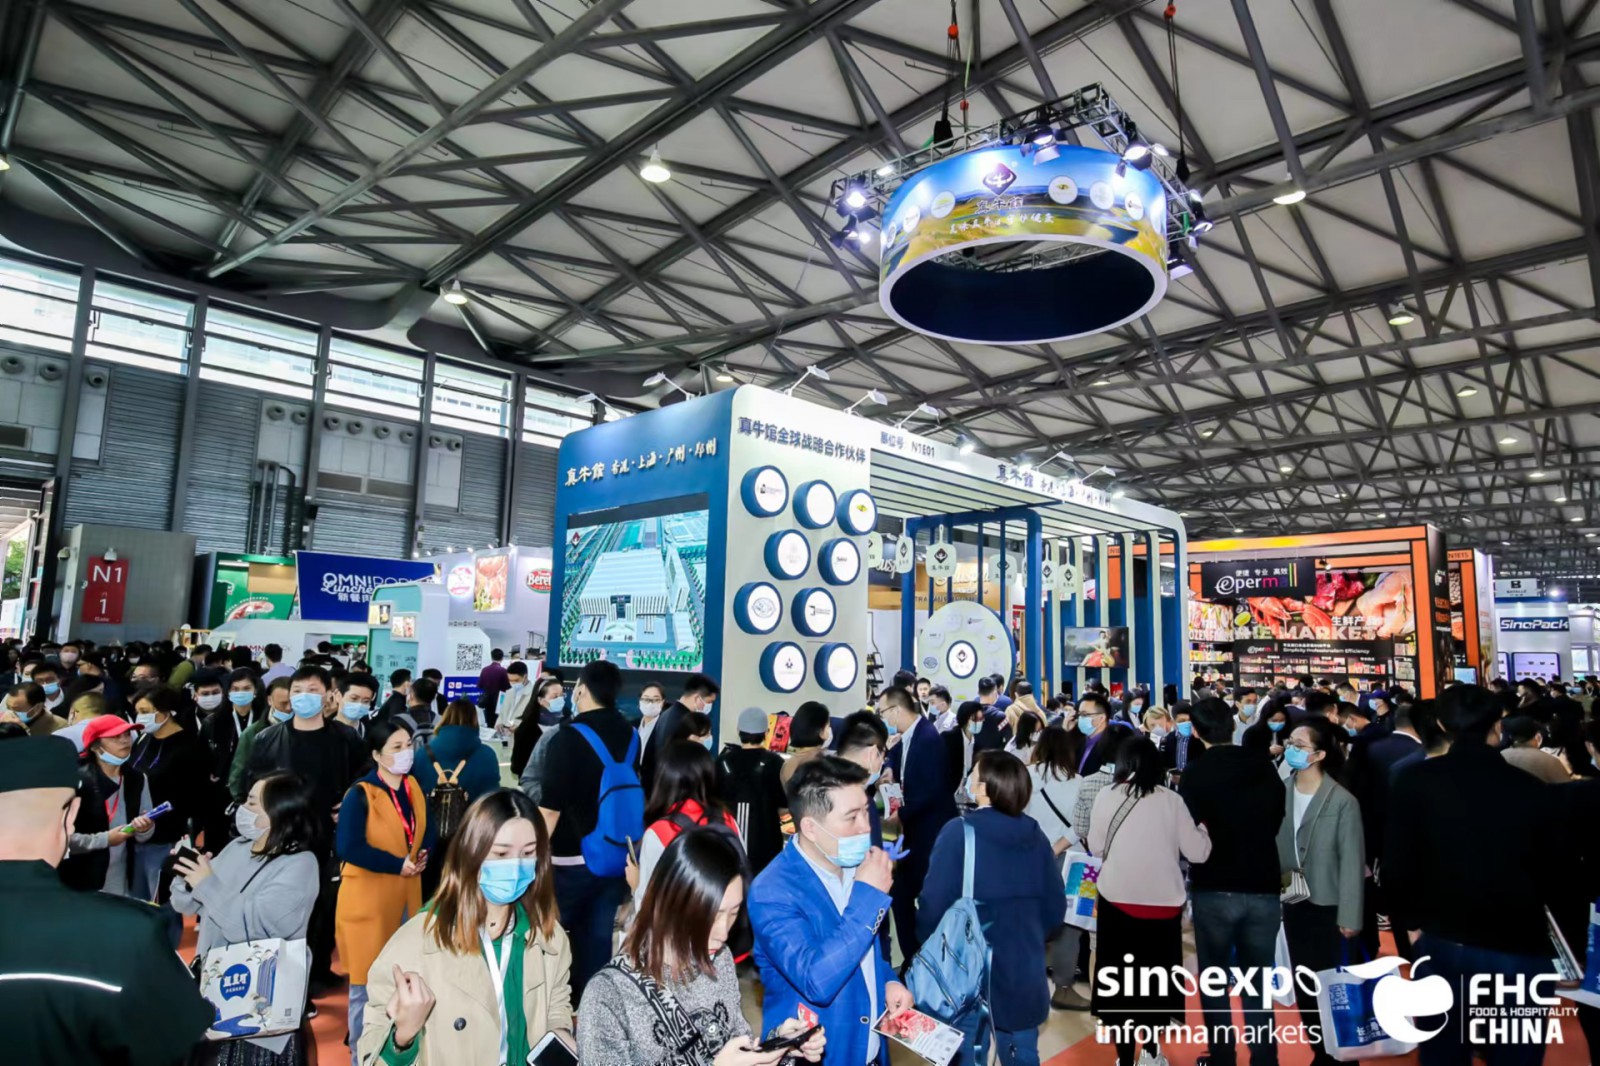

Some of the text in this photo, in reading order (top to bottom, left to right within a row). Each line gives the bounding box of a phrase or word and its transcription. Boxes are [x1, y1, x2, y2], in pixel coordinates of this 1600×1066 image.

[738, 416, 866, 463] 真牛馆全球战略合作伙伴
[911, 441, 935, 458] N1E01
[93, 565, 122, 583] N1
[321, 581, 373, 595] Lunche
[1511, 580, 1521, 588] B
[100, 598, 107, 614] 1
[1501, 619, 1569, 630] SinoPack
